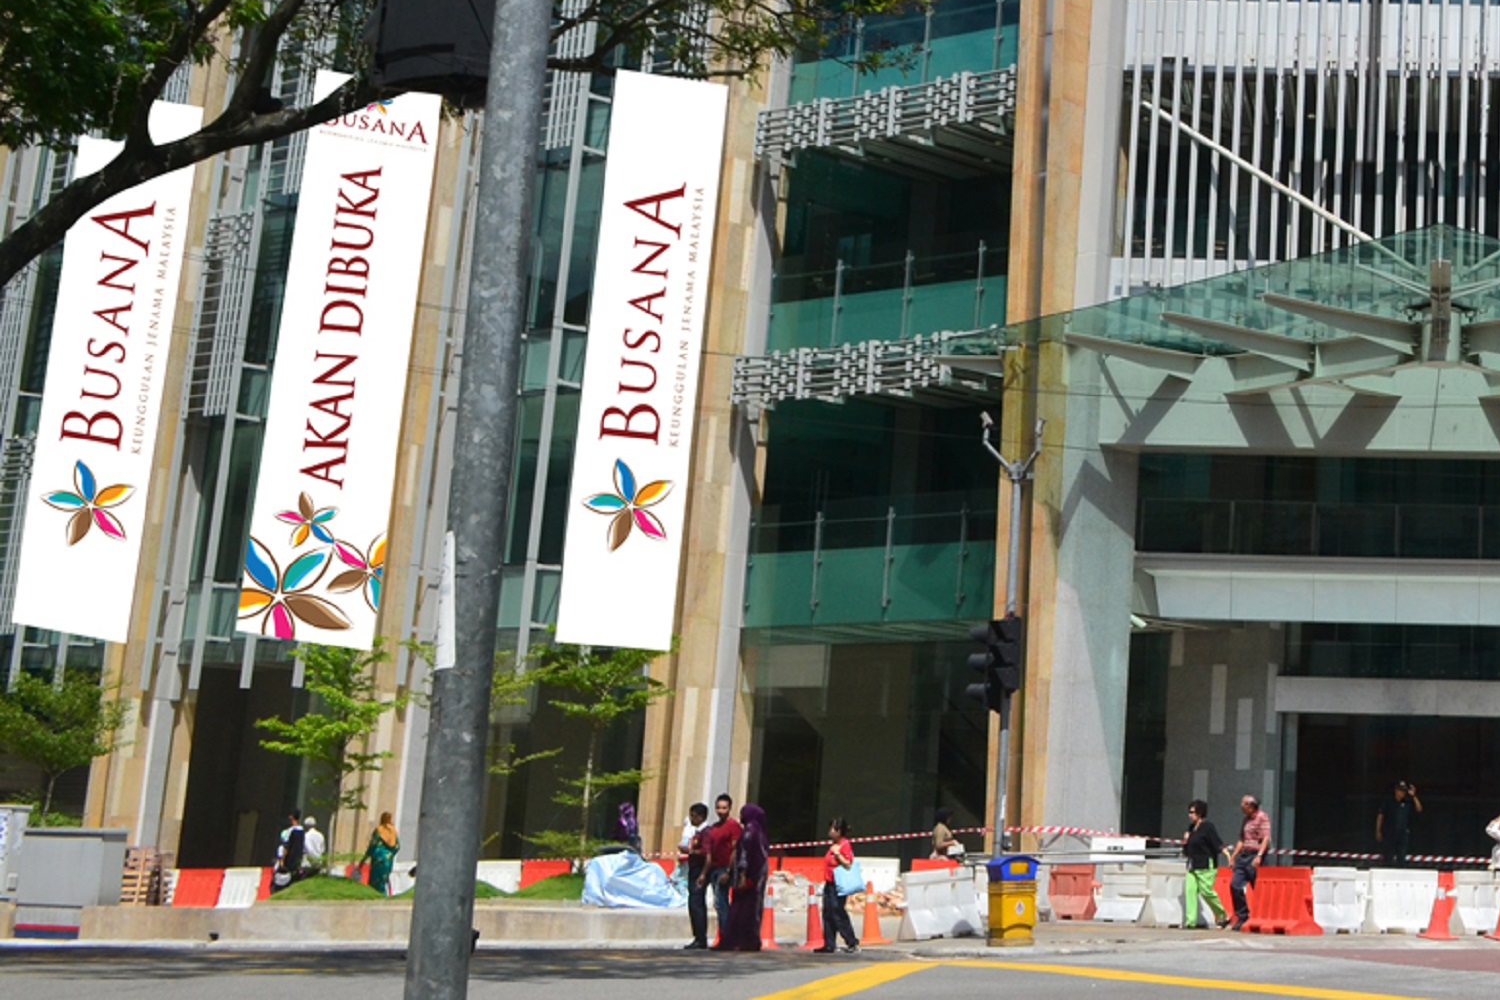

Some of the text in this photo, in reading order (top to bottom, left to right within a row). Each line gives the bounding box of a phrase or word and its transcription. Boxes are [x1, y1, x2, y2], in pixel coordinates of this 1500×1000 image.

[60, 200, 156, 451] BUSANA
[146, 288, 165, 346] JENAMA
[156, 207, 177, 279] MALAYSIA
[319, 166, 382, 336] DIBUKA
[599, 182, 687, 444] BUSANA
[681, 271, 696, 332] JENAMA
[689, 188, 705, 263] MALAYSIA
[300, 352, 358, 489] AKAN
